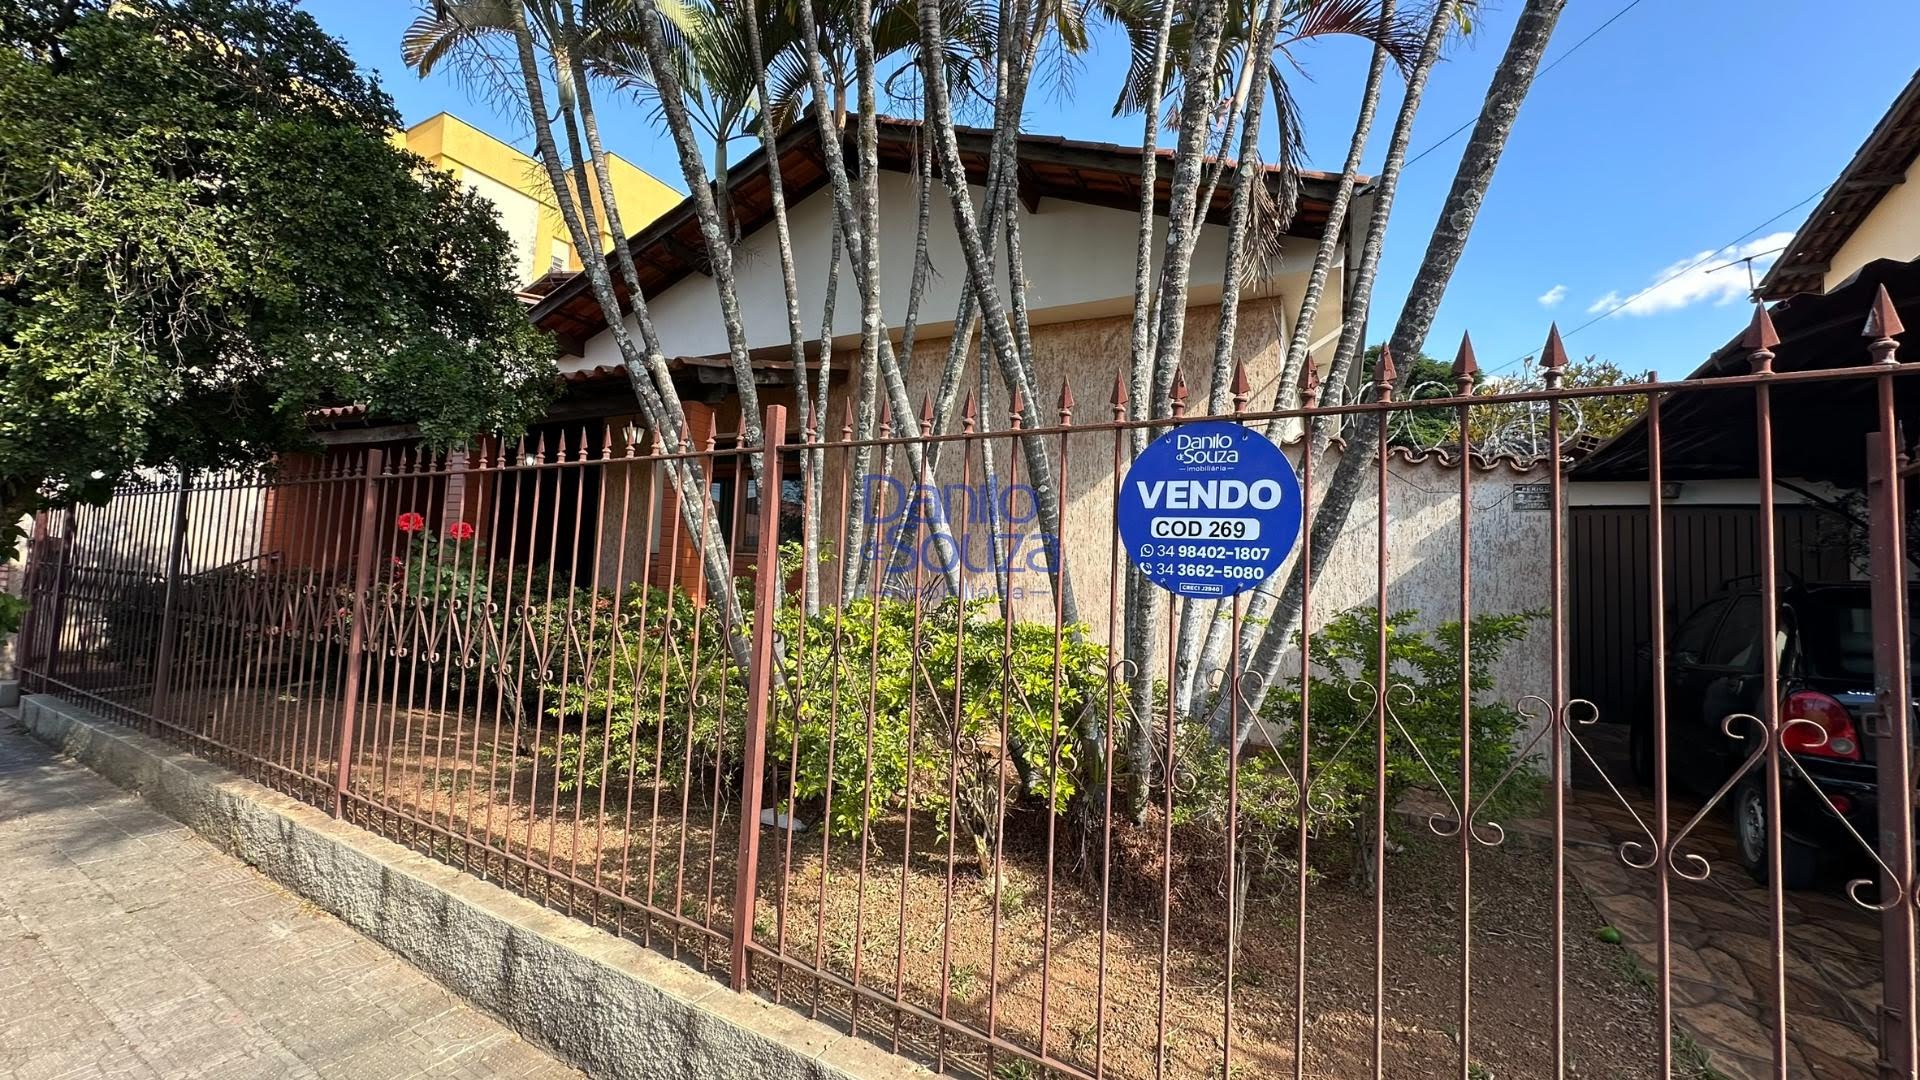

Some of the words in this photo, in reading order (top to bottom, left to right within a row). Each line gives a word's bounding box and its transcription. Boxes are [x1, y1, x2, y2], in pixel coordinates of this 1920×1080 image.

[1177, 433, 1233, 450] Danilo
[1183, 448, 1239, 464] Souza
[1136, 479, 1282, 510] VENDO
[1156, 520, 1202, 536] COD
[1208, 521, 1246, 538] 269
[1157, 544, 1175, 557] 34
[1178, 545, 1270, 561] 98402-1807
[1156, 562, 1174, 575] 34
[1177, 563, 1264, 580] 3662-5080
